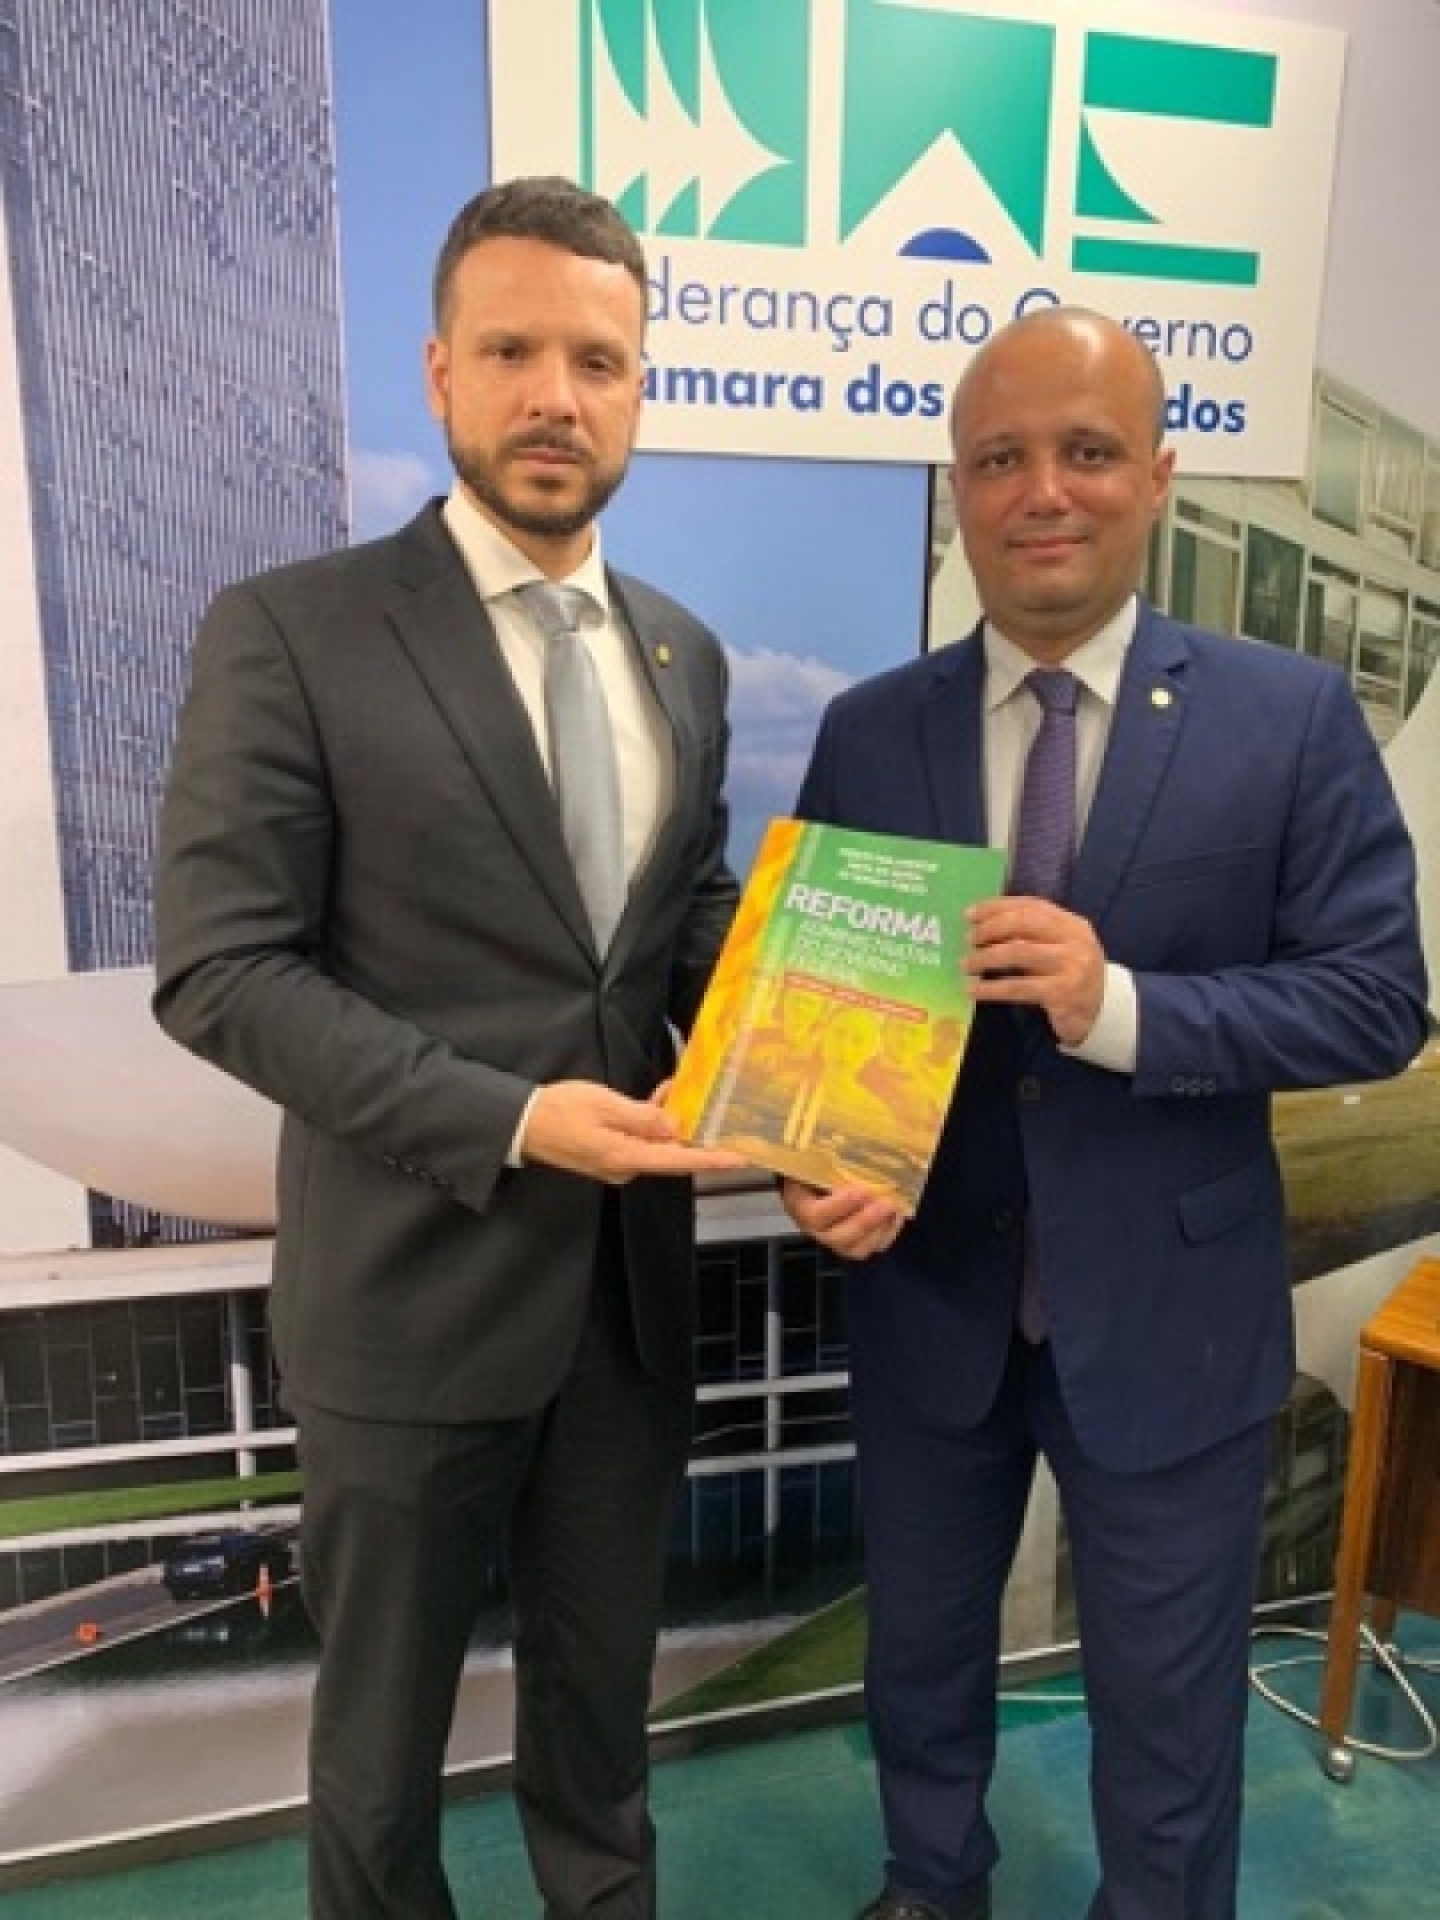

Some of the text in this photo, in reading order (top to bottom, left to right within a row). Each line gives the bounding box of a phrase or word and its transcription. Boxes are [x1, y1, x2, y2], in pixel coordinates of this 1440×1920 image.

[646, 255, 893, 352] derança
[920, 279, 991, 343] do
[846, 363, 944, 417] dos
[785, 884, 941, 944] REFORMA
